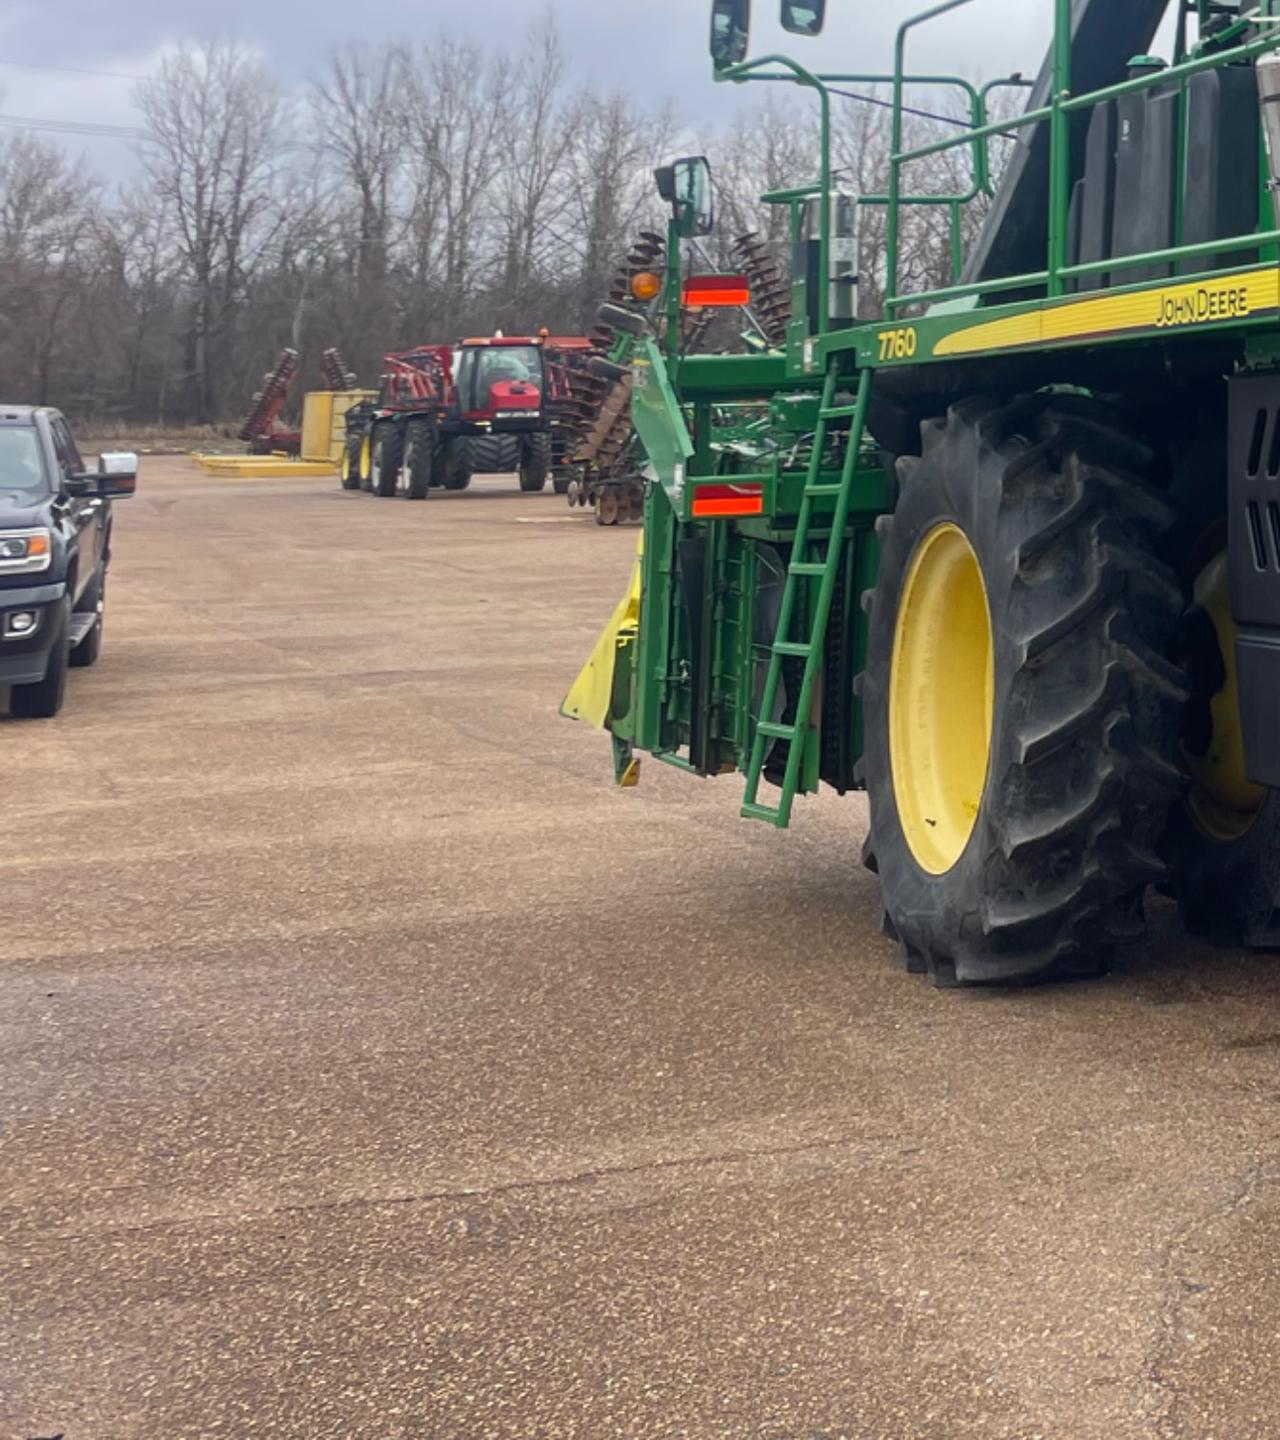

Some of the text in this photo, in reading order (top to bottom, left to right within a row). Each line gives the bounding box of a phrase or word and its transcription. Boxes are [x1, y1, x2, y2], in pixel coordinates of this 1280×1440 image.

[1157, 288, 1248, 323] JOHN DEERE
[878, 327, 916, 360] 7760
